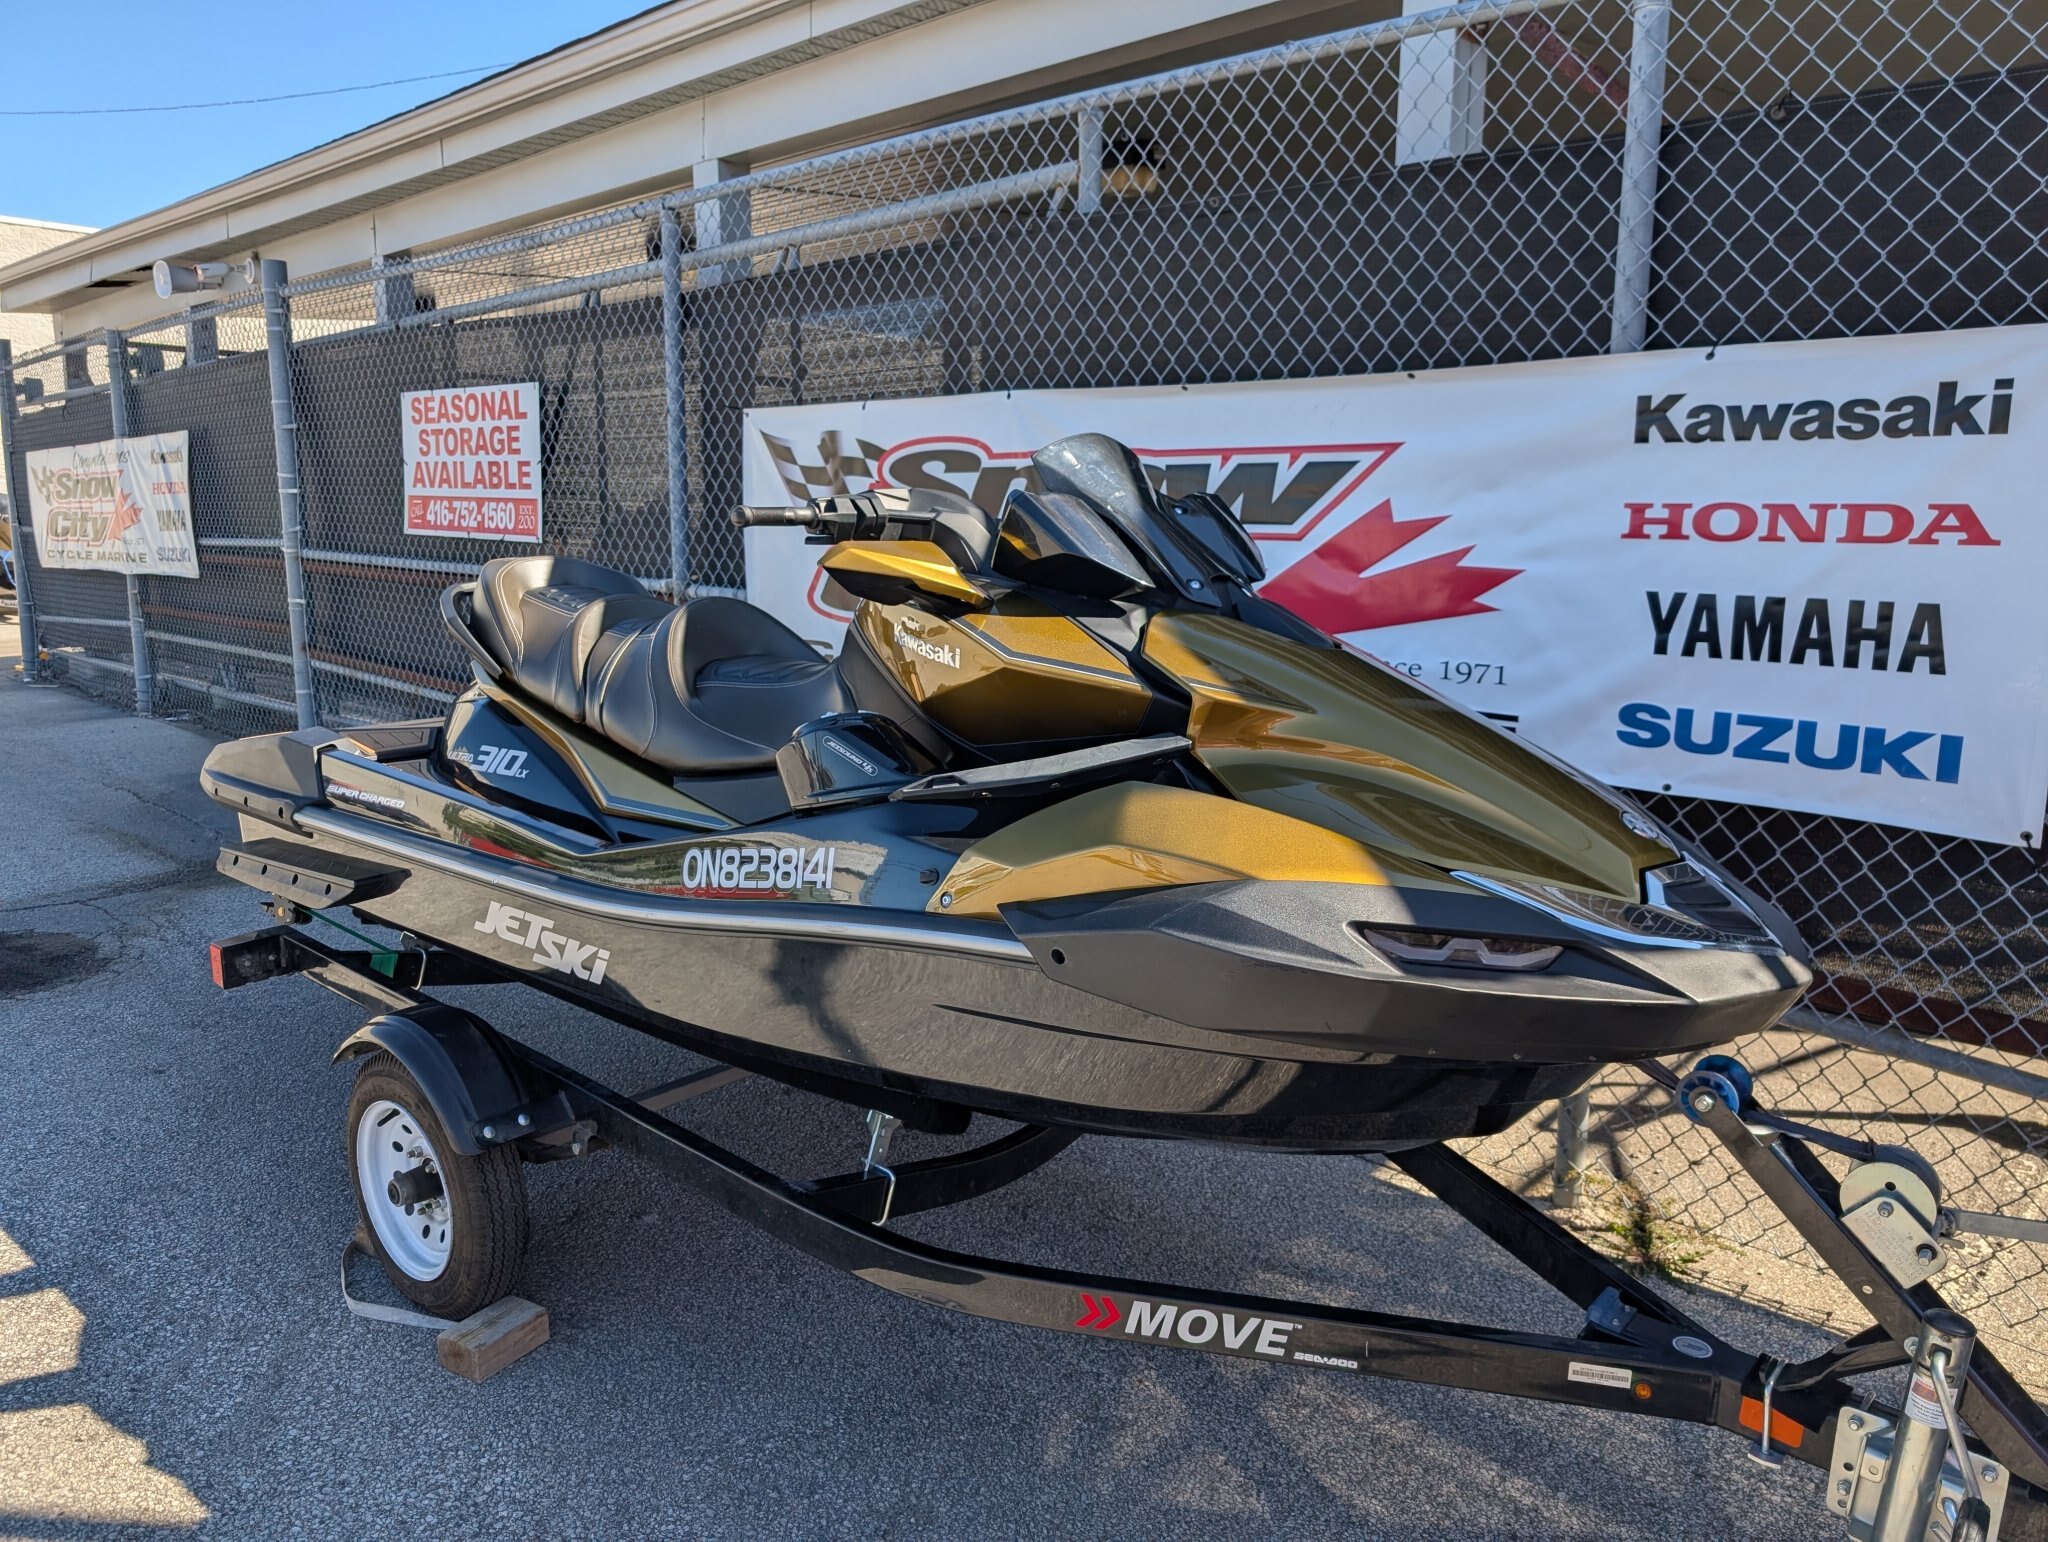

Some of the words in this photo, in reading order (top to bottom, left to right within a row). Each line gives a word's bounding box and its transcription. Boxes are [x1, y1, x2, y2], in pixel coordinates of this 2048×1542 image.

[411, 390, 528, 425] SEASONAL
[1633, 377, 2015, 444] Kawasaki
[418, 425, 521, 457] STORAGE
[55, 472, 119, 500] Snow
[412, 460, 532, 490] AVAILABLE
[49, 508, 111, 542] City
[411, 504, 424, 518] CALL
[426, 500, 516, 530] 416-752-1560
[518, 515, 535, 529] 200
[1620, 502, 2001, 546] HONDA
[47, 549, 93, 561] CYCLE
[97, 551, 148, 563] MARINE
[893, 622, 961, 670] Kawasaki
[1645, 590, 1947, 676] YAMAHA
[1439, 660, 1508, 686] 1971
[447, 751, 474, 762] ULTRA
[469, 744, 528, 776] 310
[1616, 702, 1965, 785] SUZUKI
[682, 847, 835, 889] ON8238141
